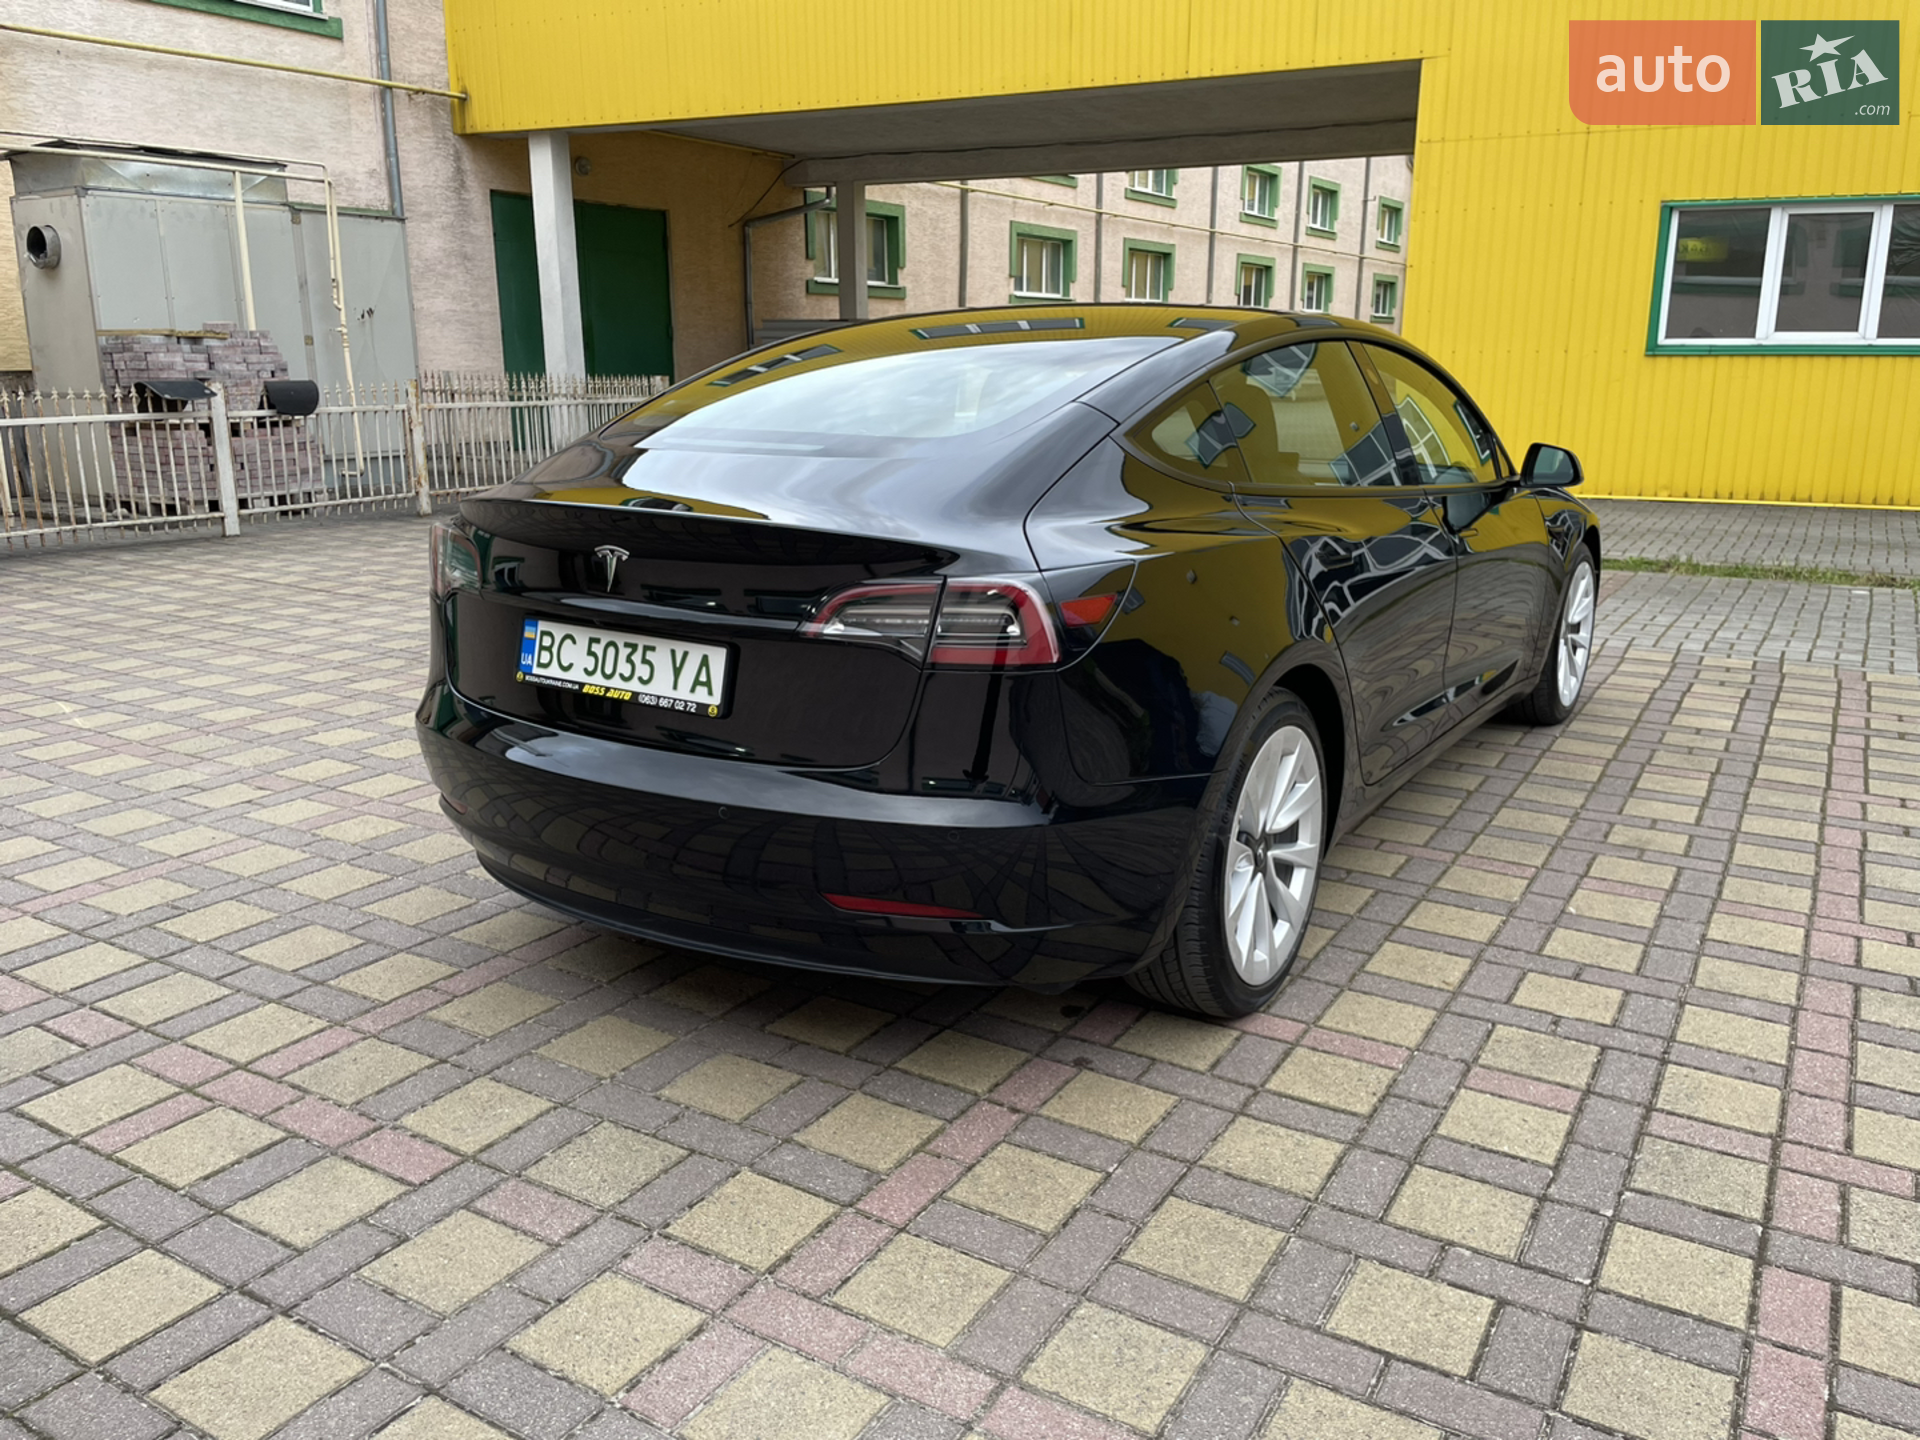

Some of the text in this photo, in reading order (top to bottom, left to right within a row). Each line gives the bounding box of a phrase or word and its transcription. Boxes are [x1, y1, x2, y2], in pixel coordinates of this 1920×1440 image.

[520, 653, 533, 666] UA
[536, 630, 714, 697] BC 5035 YA
[582, 684, 633, 701] BOSS AUTO
[638, 693, 697, 713] (063) 667 02 72
